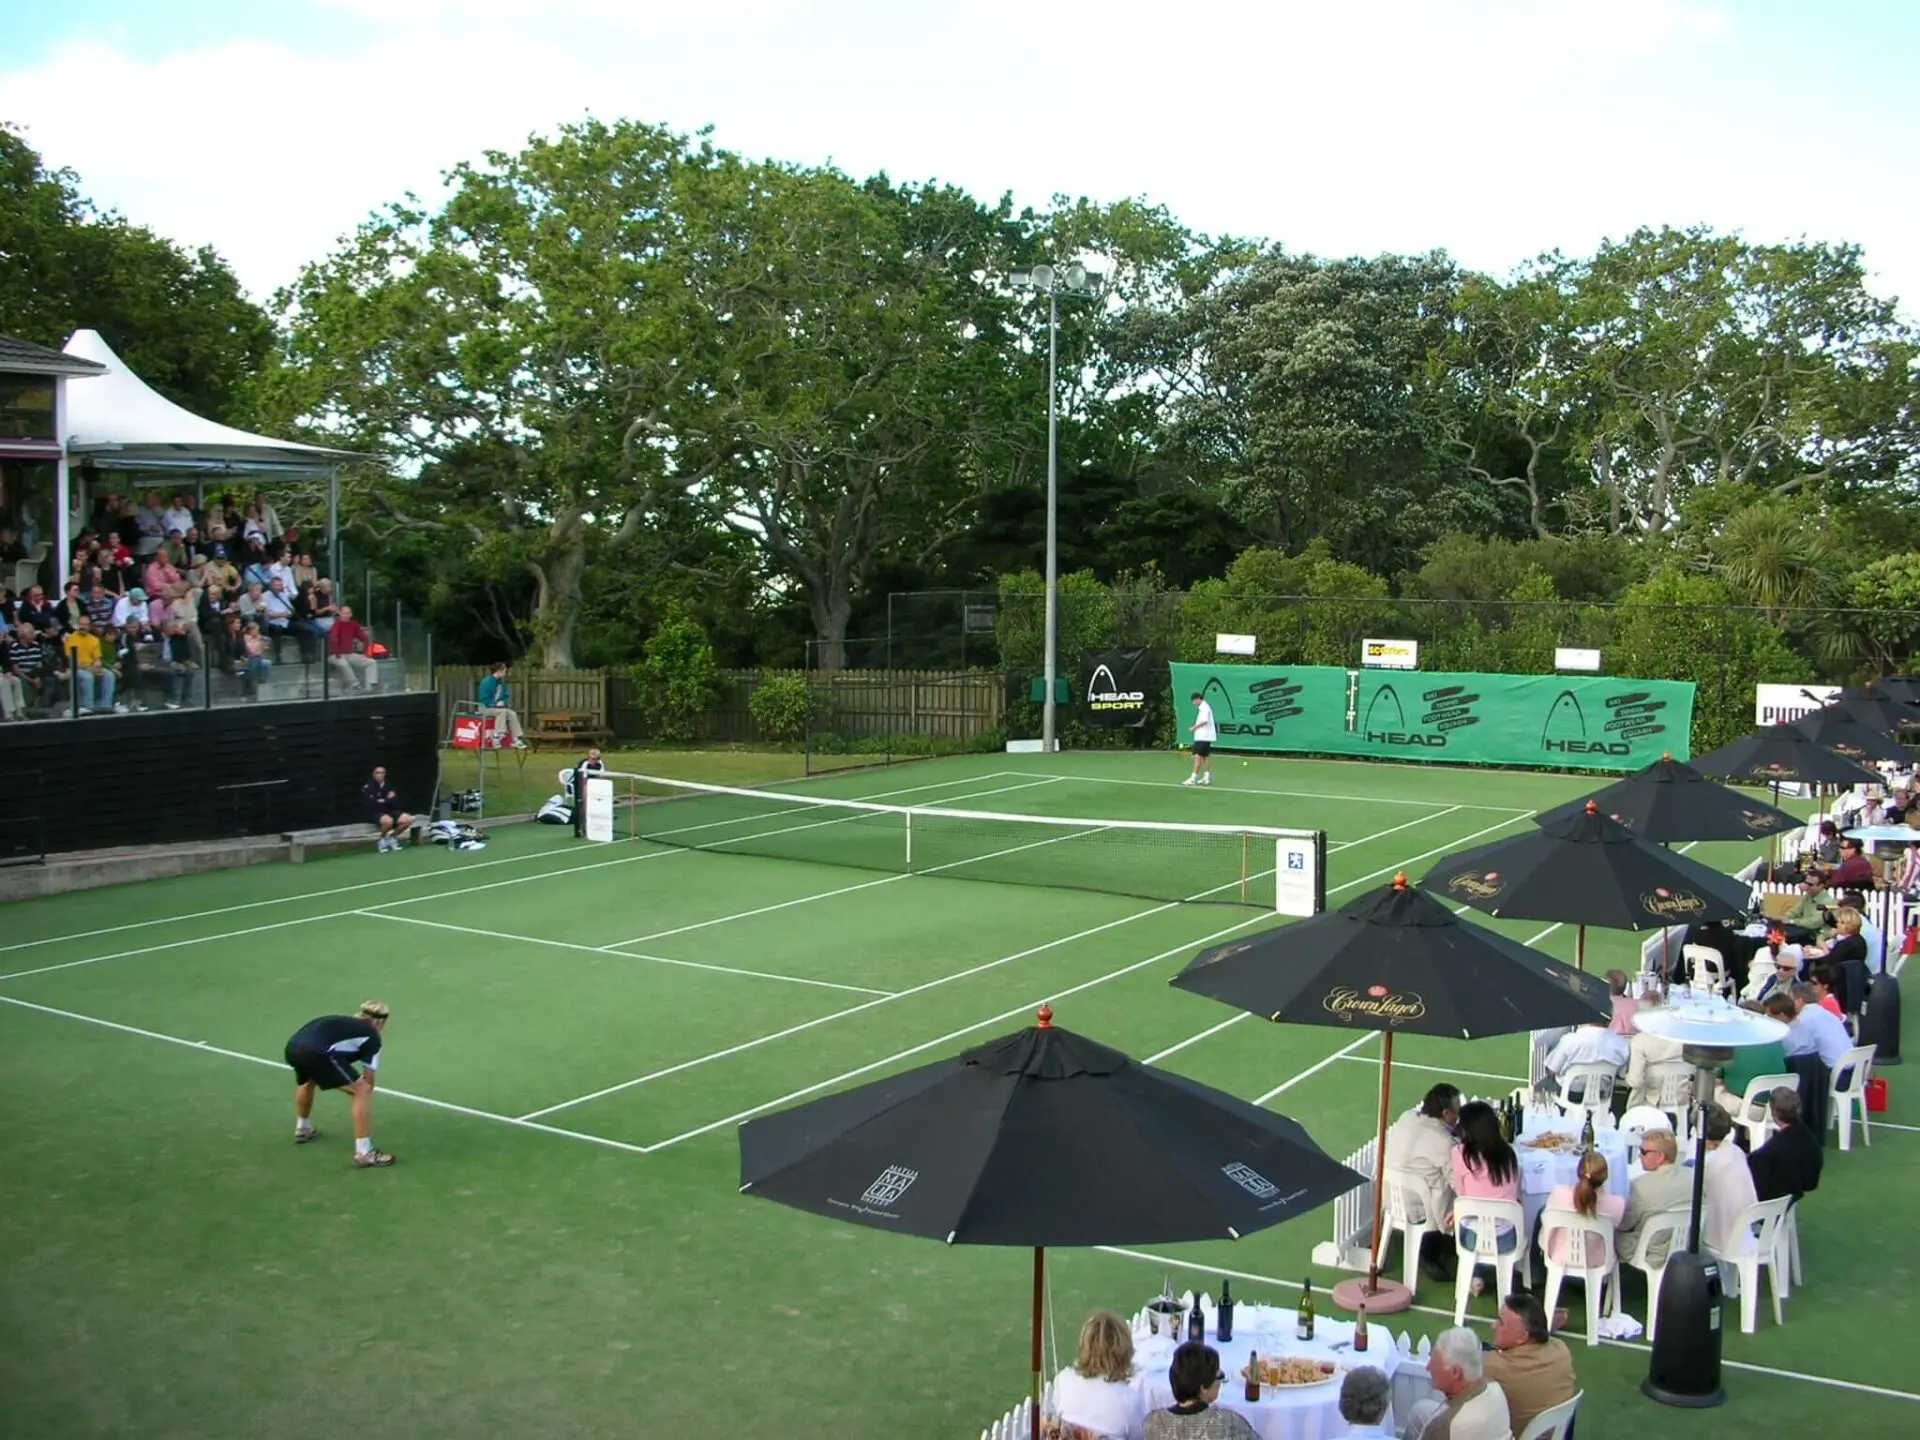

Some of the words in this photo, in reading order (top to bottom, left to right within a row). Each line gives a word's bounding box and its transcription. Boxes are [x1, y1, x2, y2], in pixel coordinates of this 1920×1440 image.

[1091, 691, 1144, 701] HEAD
[1091, 702, 1144, 710] SPORT
[1763, 706, 1820, 723] PUM
[1215, 723, 1274, 736] EAD
[1367, 731, 1447, 747] HEAD
[1545, 739, 1630, 755] HEAD
